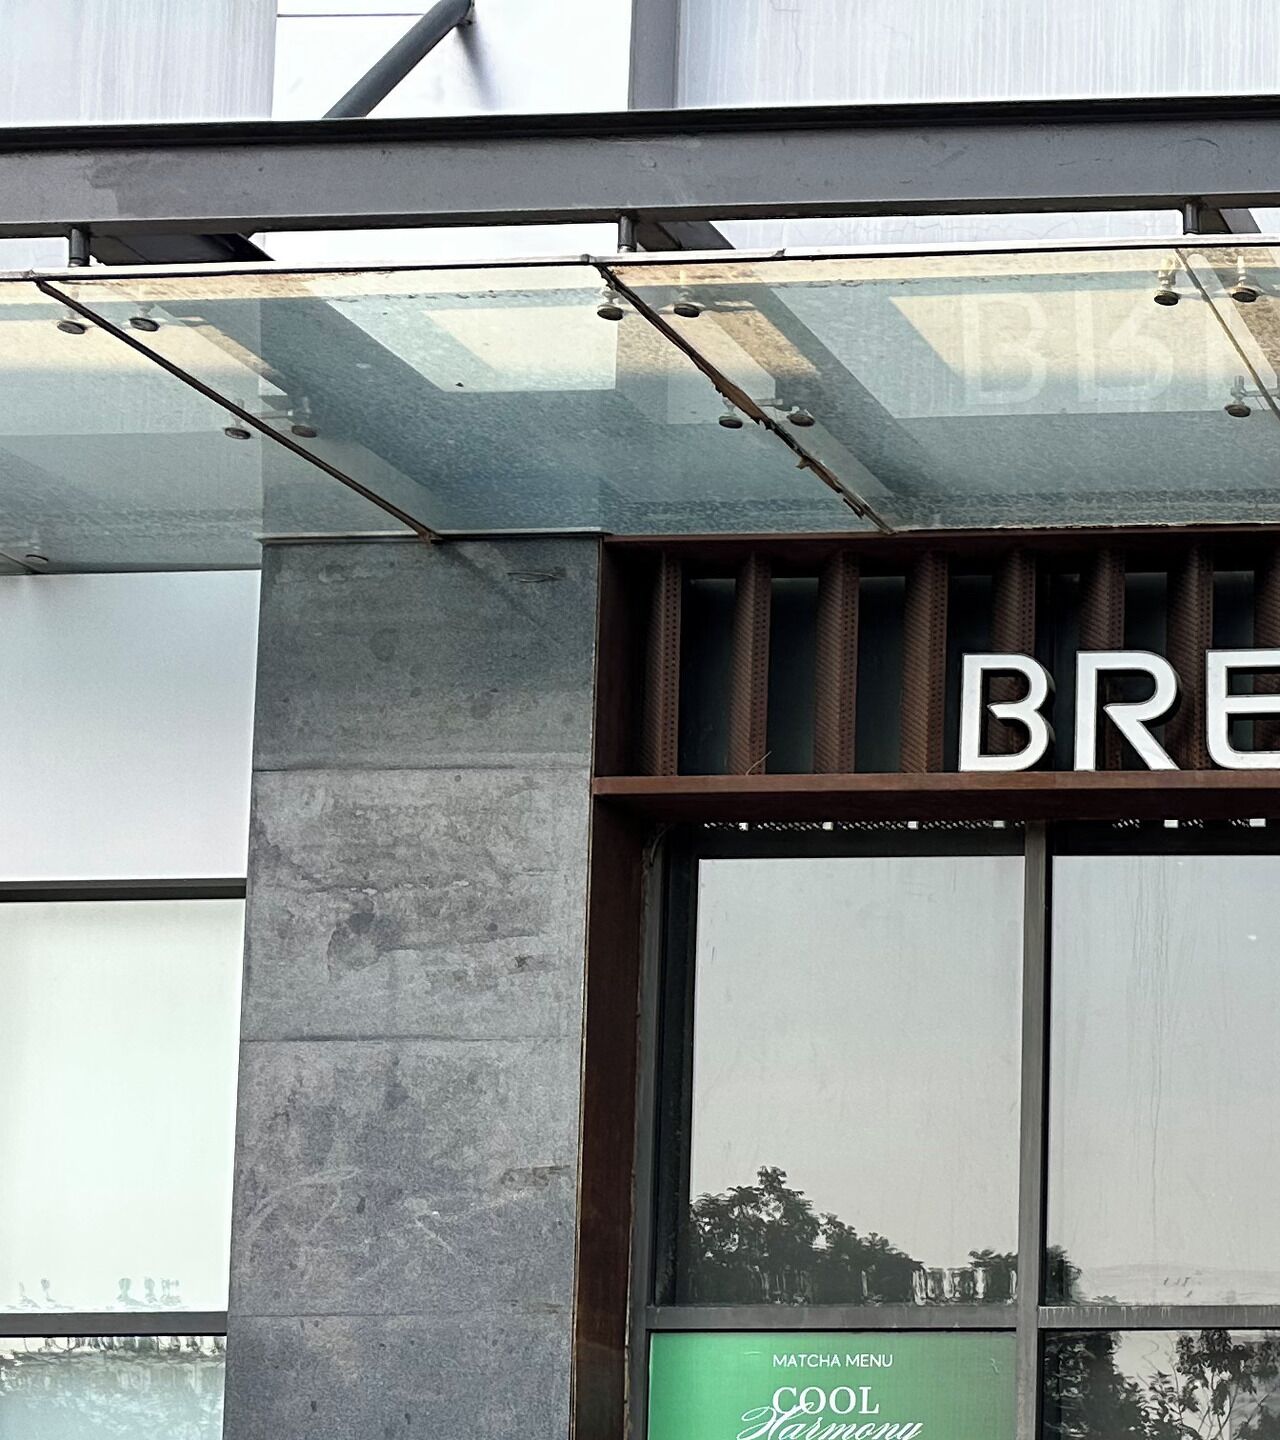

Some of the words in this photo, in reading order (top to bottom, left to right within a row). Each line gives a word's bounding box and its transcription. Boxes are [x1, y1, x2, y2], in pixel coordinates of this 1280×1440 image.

[773, 1354, 841, 1367] MATCHA
[846, 1354, 893, 1367] MENU
[772, 1386, 879, 1415] COOL
